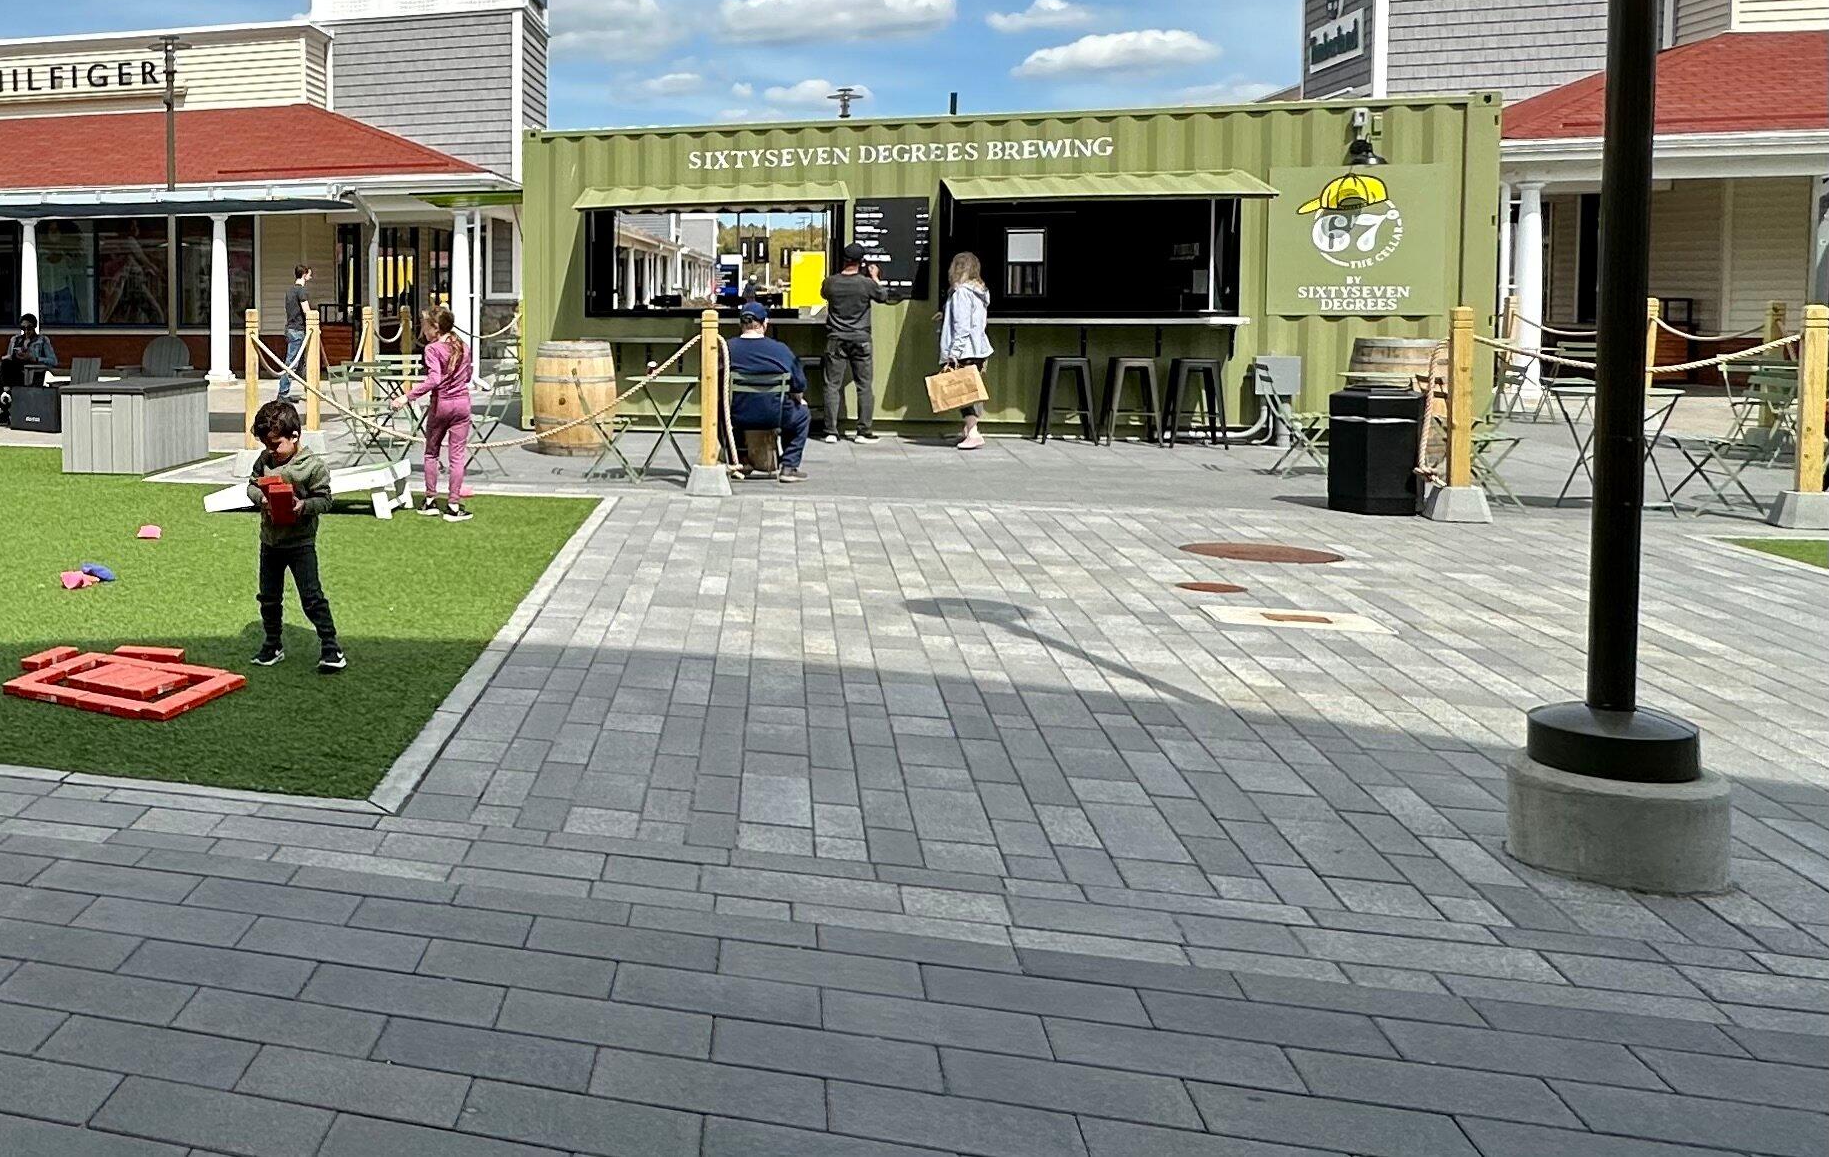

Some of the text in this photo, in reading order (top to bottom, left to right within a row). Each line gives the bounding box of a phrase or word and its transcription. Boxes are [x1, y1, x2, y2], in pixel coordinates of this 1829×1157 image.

[688, 136, 1114, 171] SIXTYSEVEN DEGREES BREWING
[1350, 226, 1404, 269] THE CELLAR
[1346, 275, 1362, 285] BY
[1297, 285, 1411, 299] SIXTYSEVEN
[1320, 298, 1398, 311] DEGREES
